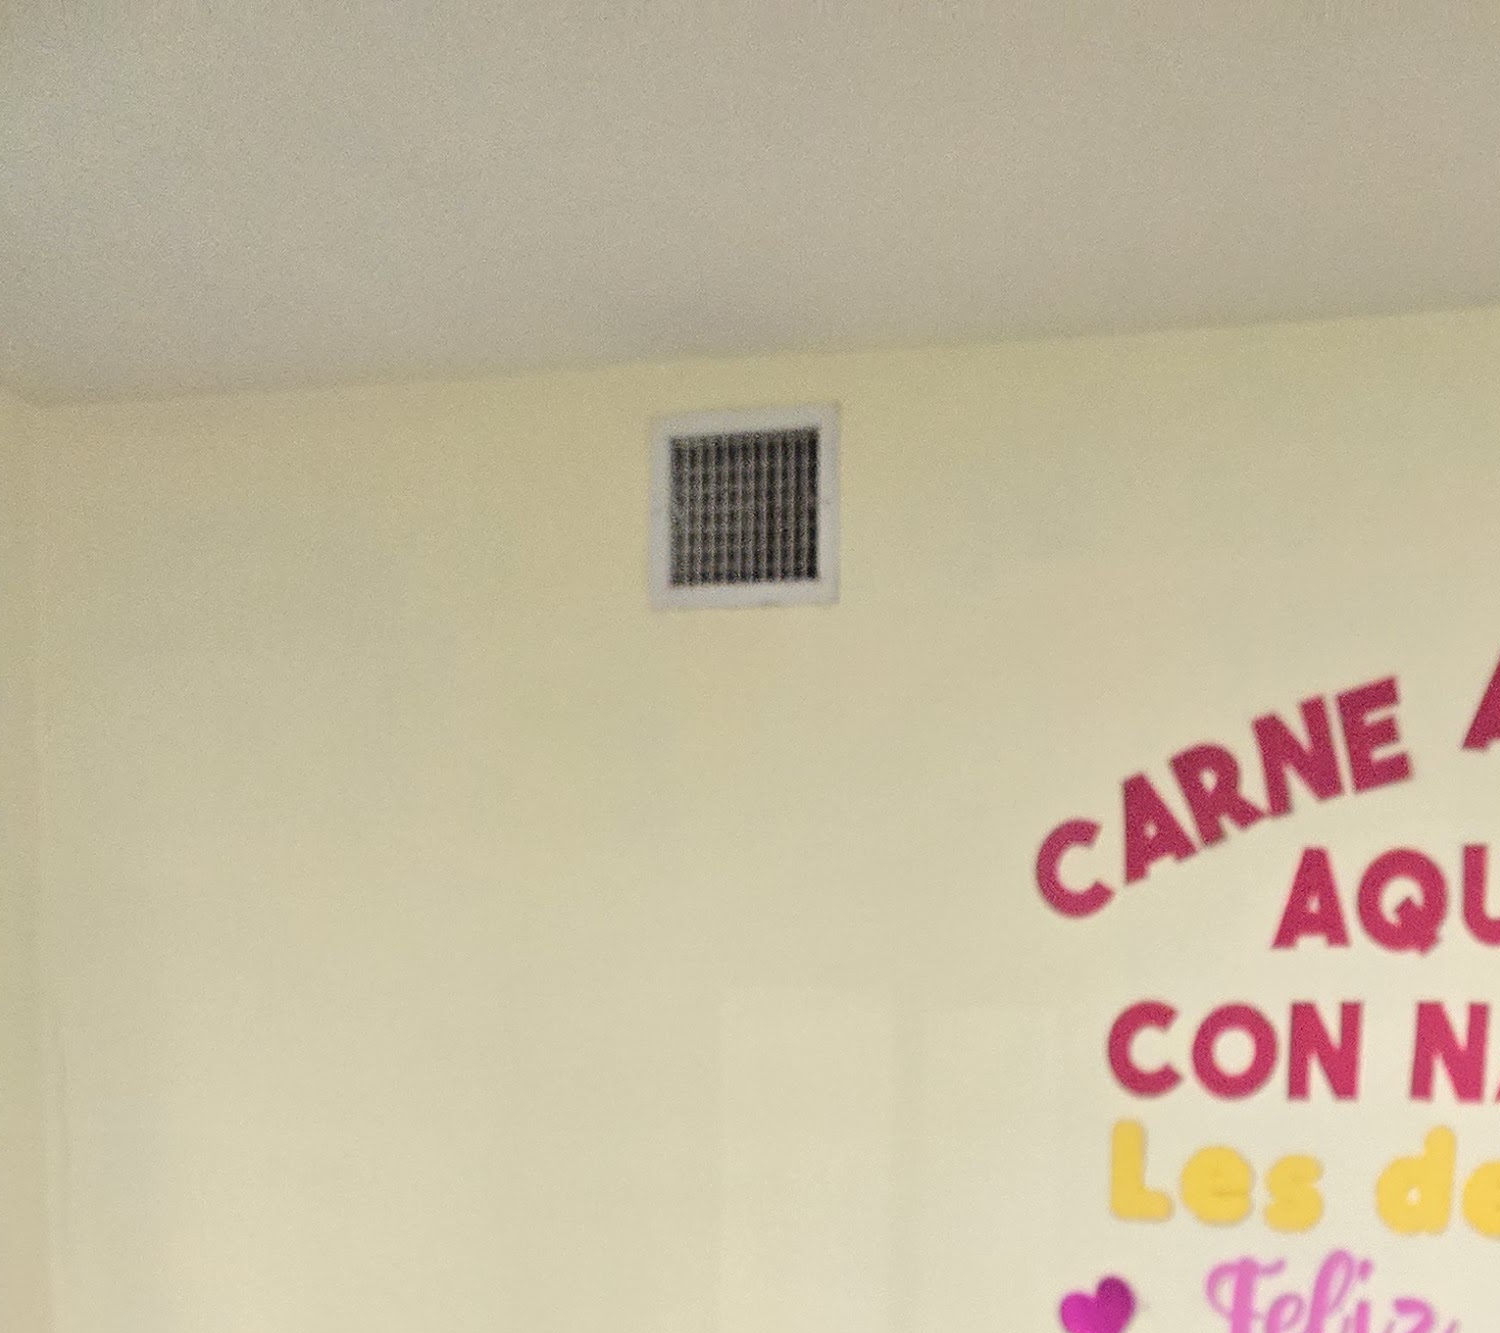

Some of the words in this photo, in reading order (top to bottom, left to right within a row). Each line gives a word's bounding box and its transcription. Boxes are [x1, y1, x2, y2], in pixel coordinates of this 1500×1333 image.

[1034, 676, 1413, 919] CARNE
[1106, 999, 1364, 1102] CON
[1109, 1119, 1325, 1232] Les
